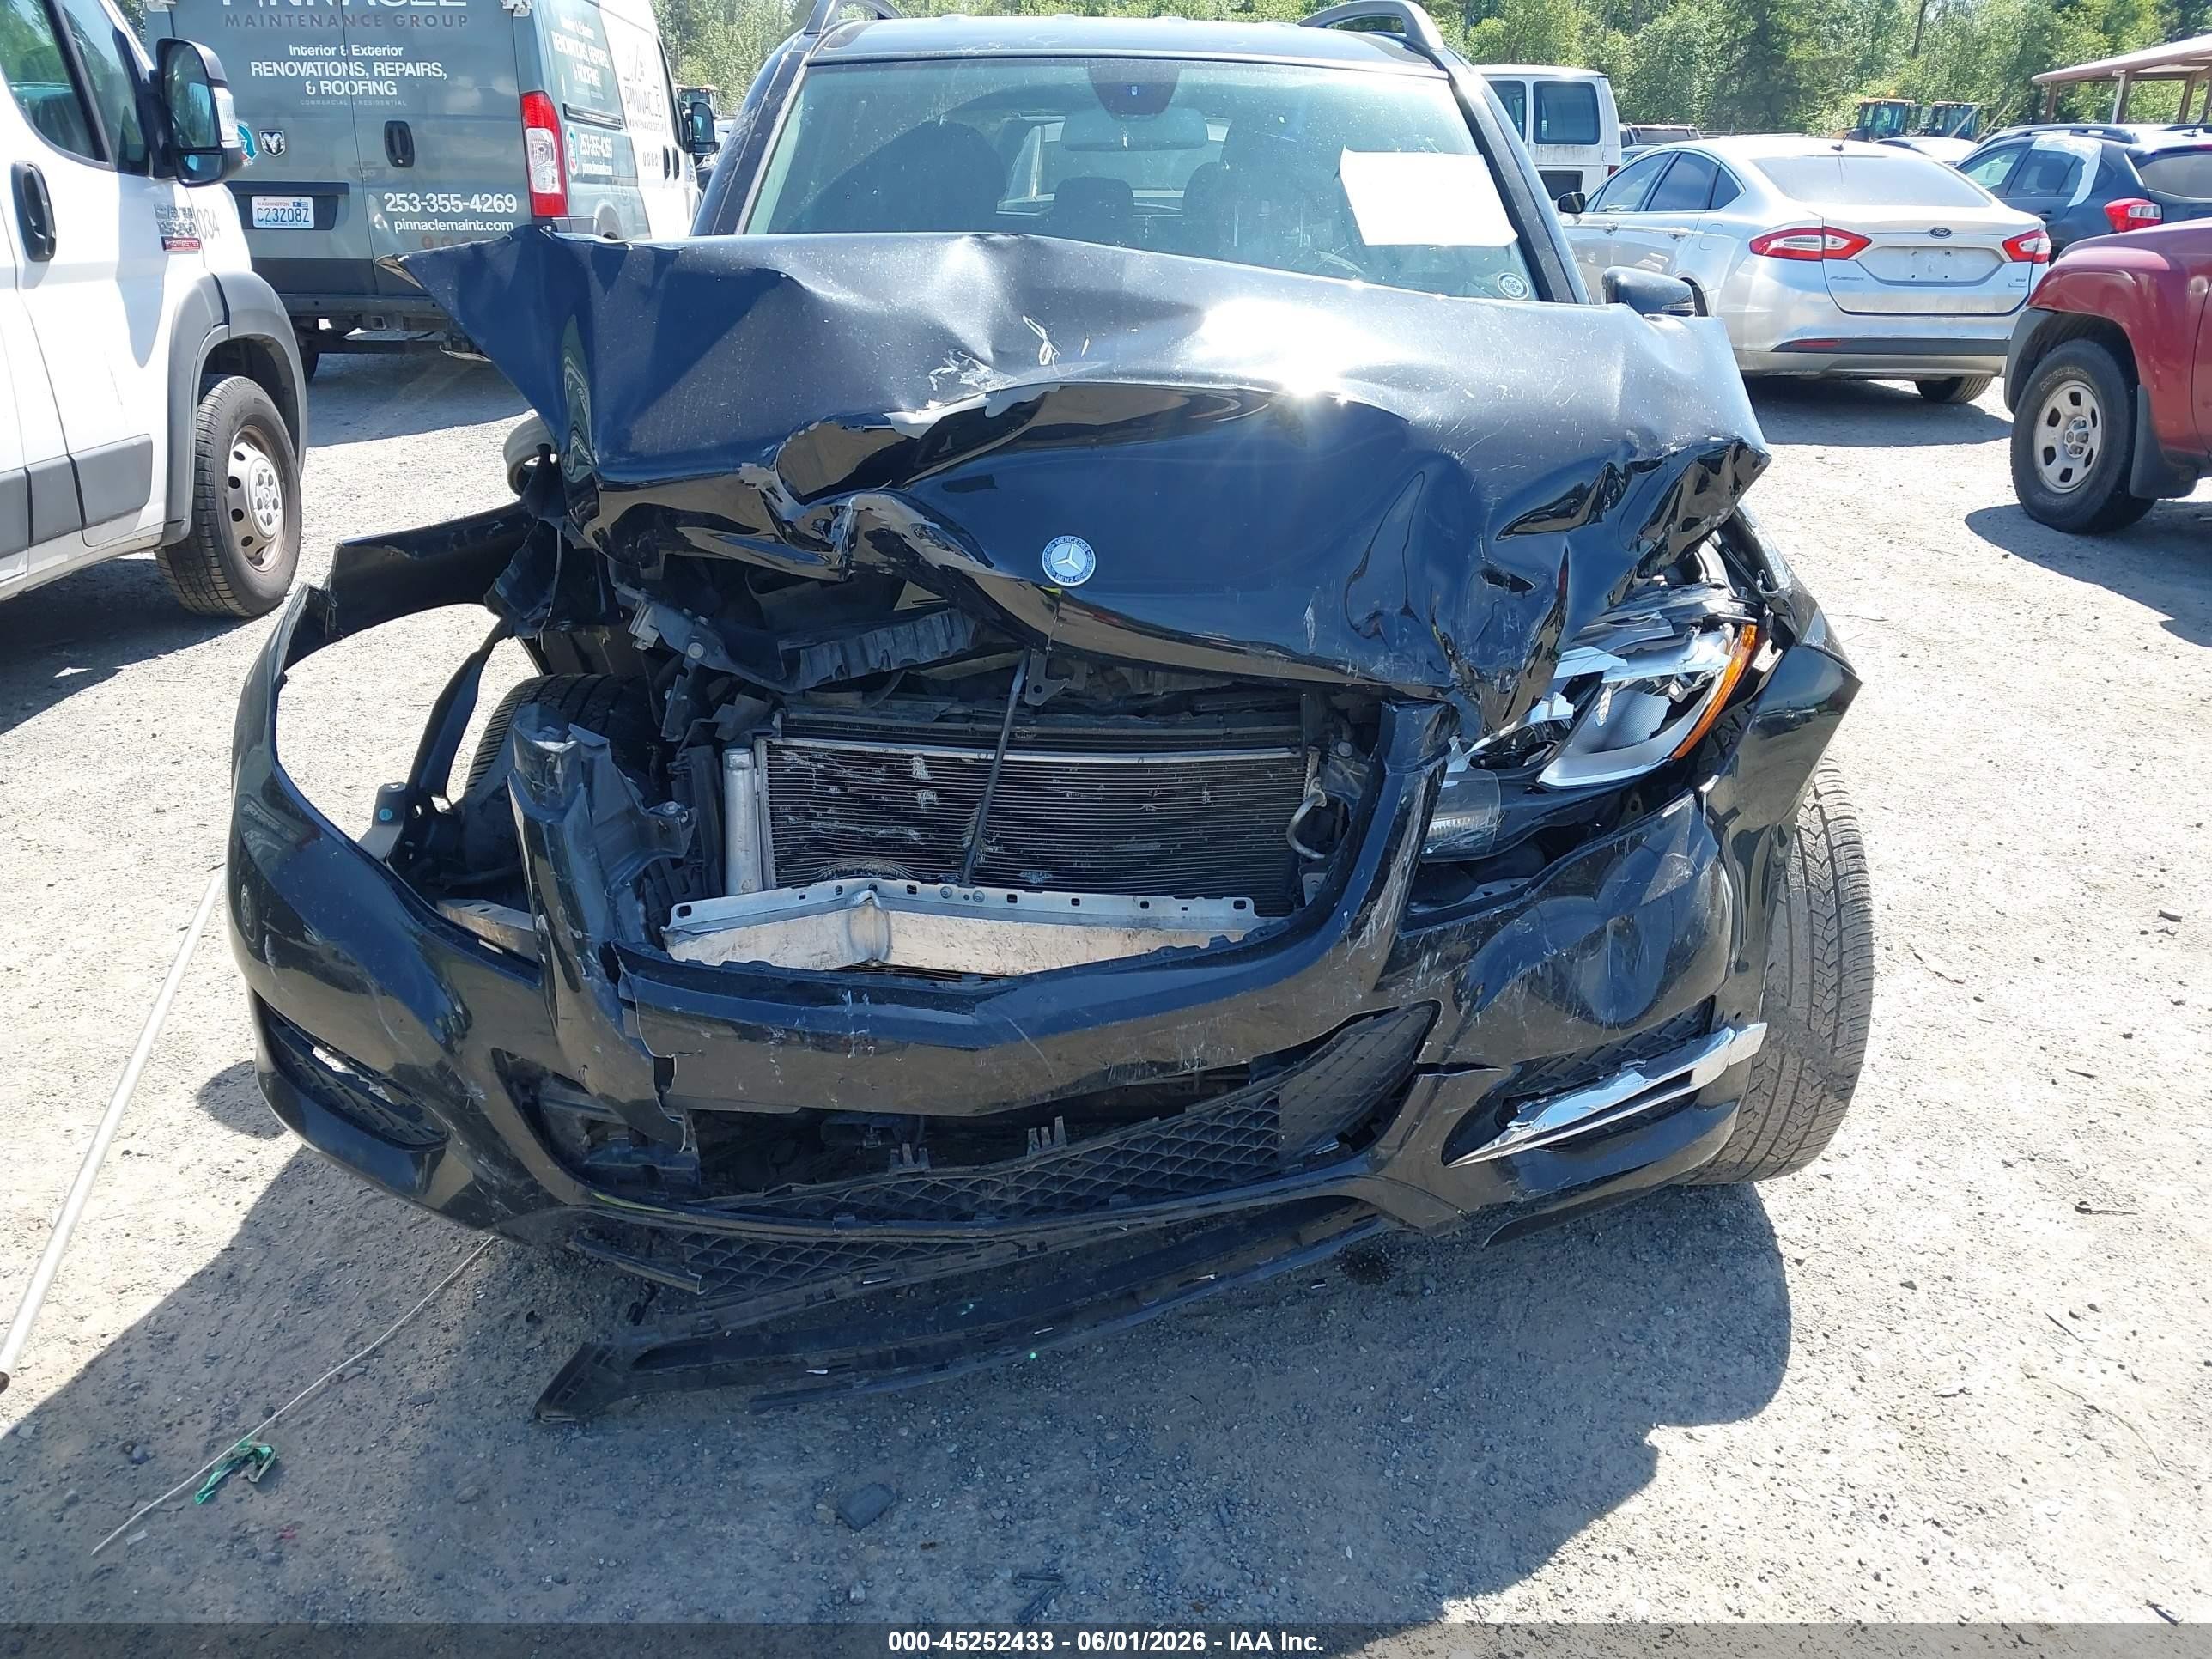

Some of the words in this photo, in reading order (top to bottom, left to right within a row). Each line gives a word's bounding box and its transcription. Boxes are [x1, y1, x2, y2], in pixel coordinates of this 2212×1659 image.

[224, 13, 383, 28] MAINTENANCE
[392, 14, 469, 28] GROUP
[289, 45, 337, 56] Interior
[351, 45, 404, 57] Exterior
[250, 61, 370, 79] RENOVATIONS,
[373, 62, 447, 81] REPAIRS,
[306, 82, 316, 96] &
[320, 81, 398, 96] ROOFING
[384, 192, 517, 213] 253-355-4269
[257, 208, 310, 222] C23208Z
[393, 218, 514, 234] pinnaclemaint.com
